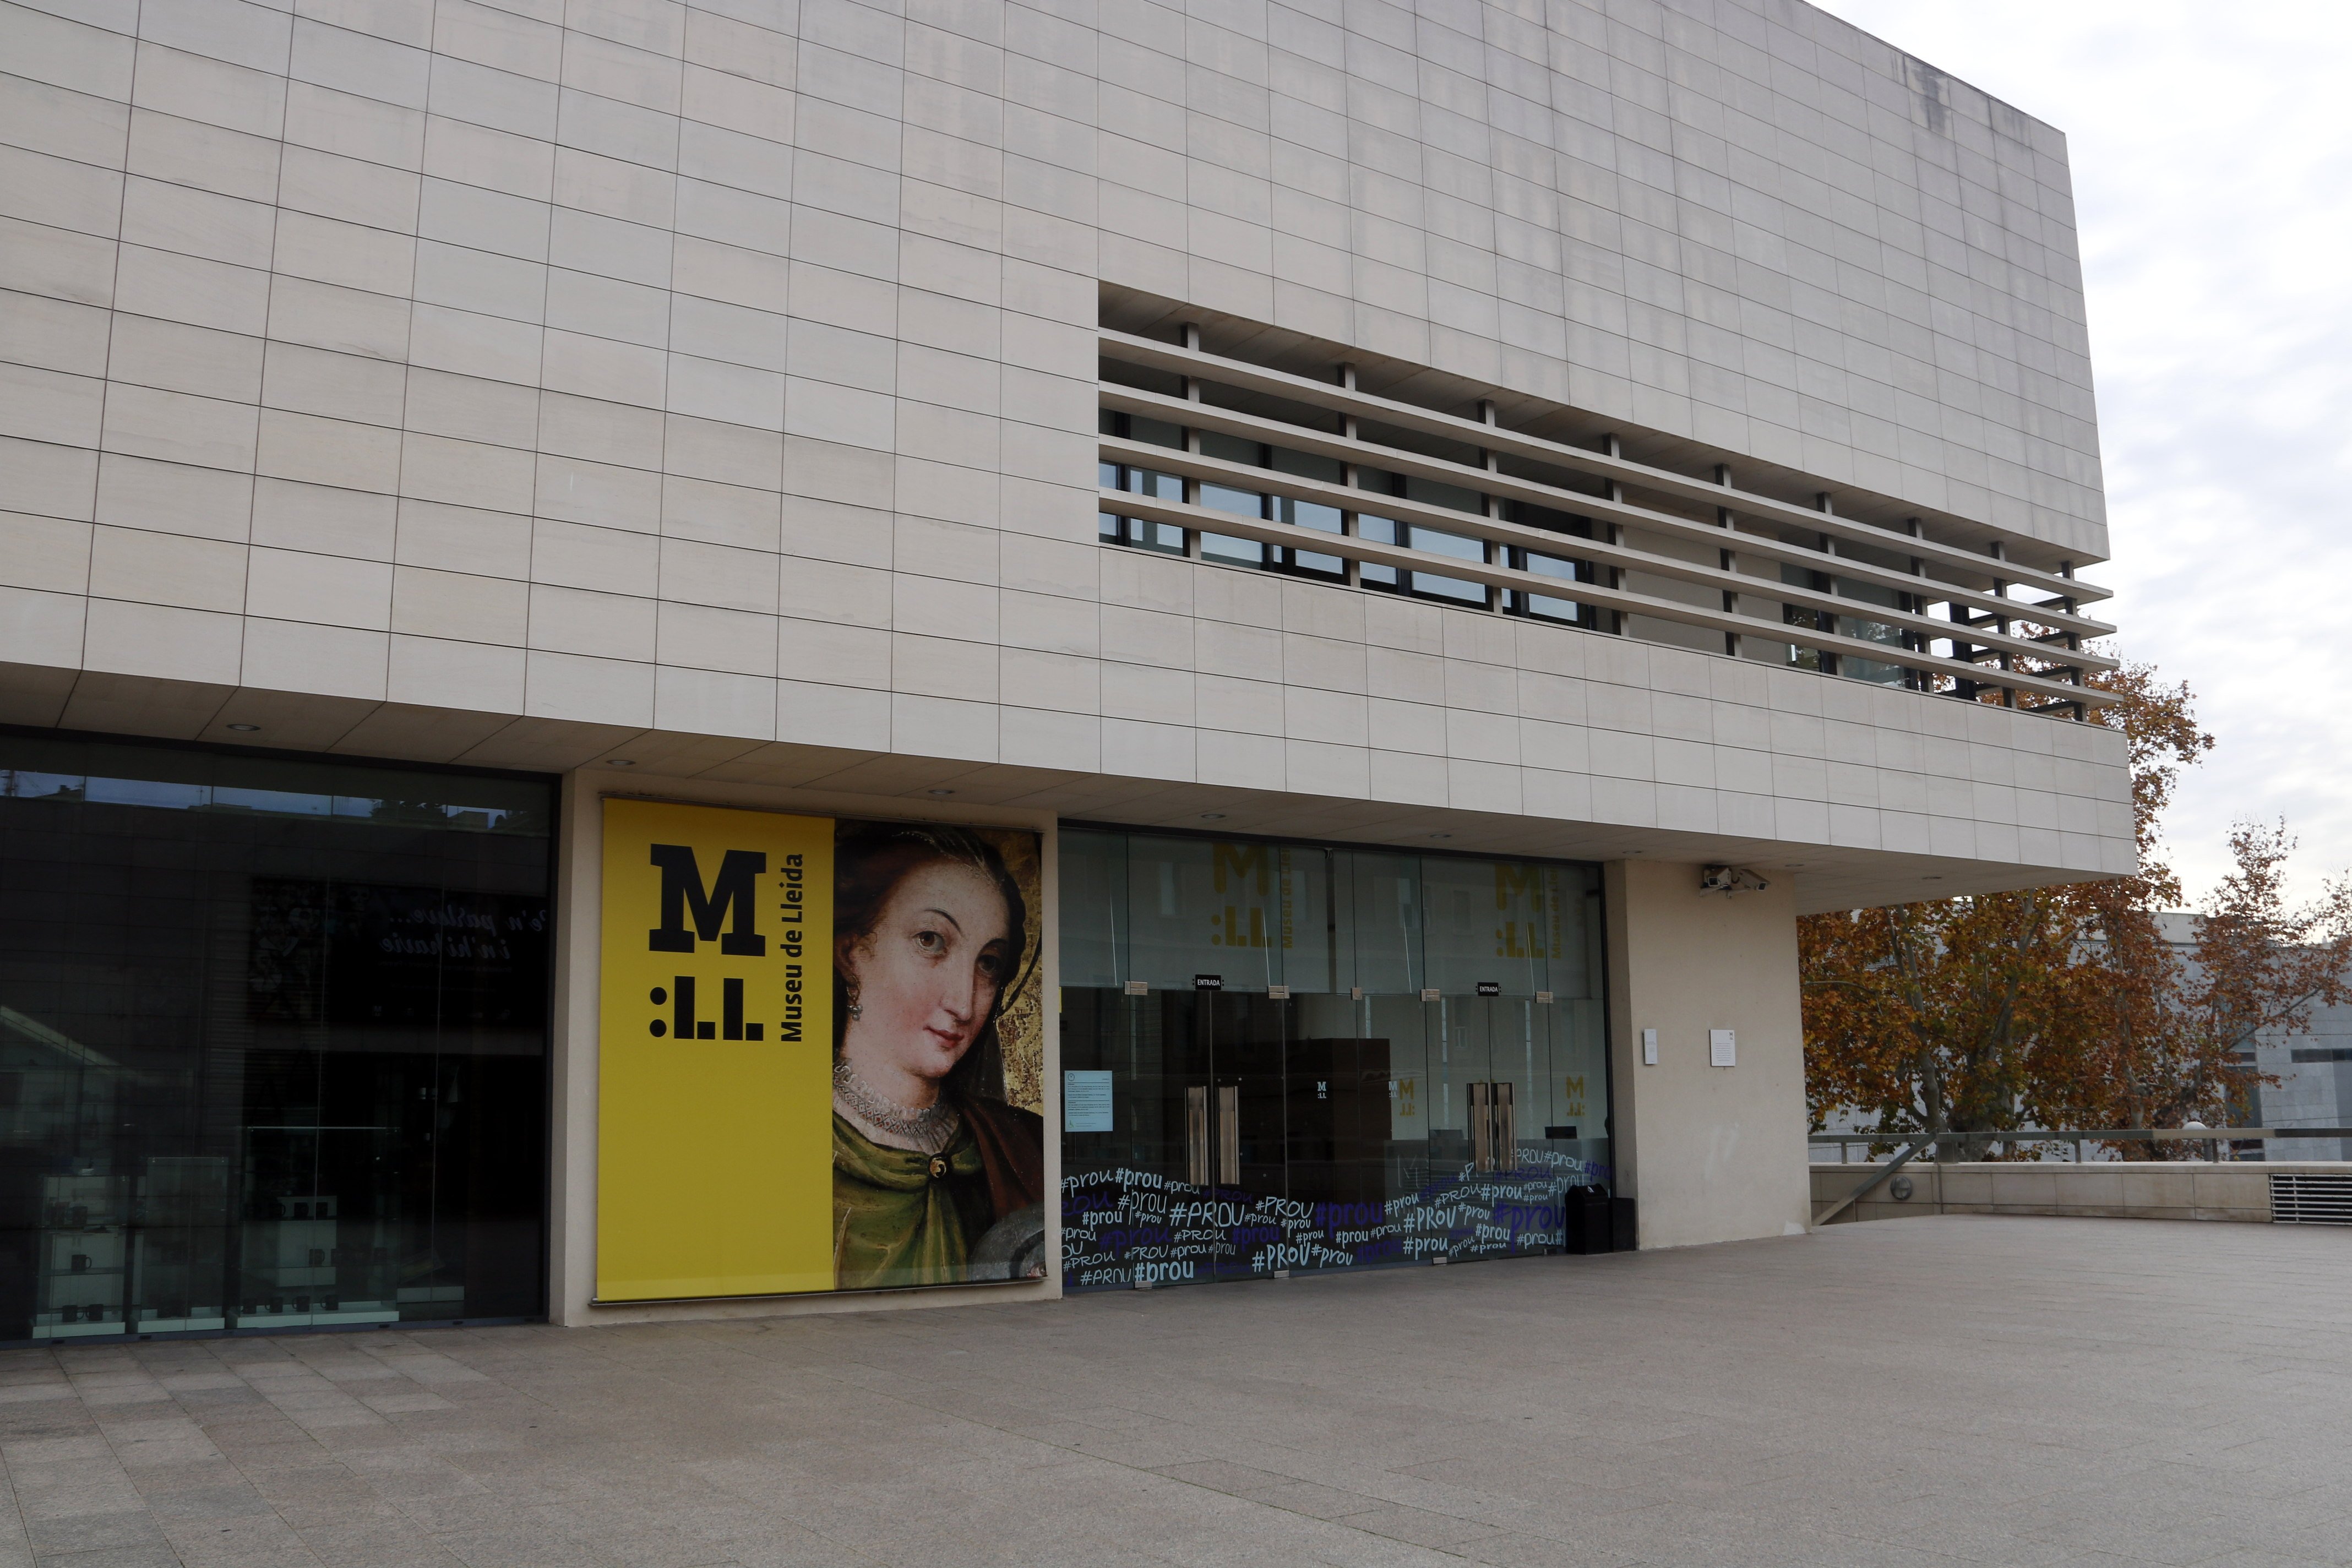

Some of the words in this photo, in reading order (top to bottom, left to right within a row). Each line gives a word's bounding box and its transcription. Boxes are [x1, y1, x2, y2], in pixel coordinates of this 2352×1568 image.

[1212, 842, 1269, 896] M
[1281, 849, 1292, 874] Llei
[778, 854, 803, 923] Lleida
[1495, 862, 1542, 912] M
[649, 843, 766, 956] M
[1282, 900, 1293, 949] Museu
[780, 930, 802, 957] de
[1551, 916, 1561, 959] Museu
[781, 965, 802, 1042] Museu
[1317, 1081, 1326, 1091] M
[1544, 1151, 1582, 1172] #prou
[1585, 1160, 1611, 1182] #pro
[1061, 1169, 1113, 1197] #prou
[1115, 1168, 1162, 1192] #prou
[1164, 1180, 1200, 1194] #prou
[1523, 1180, 1547, 1193] #prou
[1384, 1193, 1419, 1217] #prou
[1435, 1183, 1482, 1209] #PROU
[1480, 1184, 1522, 1207] #prou
[1523, 1194, 1548, 1205] #prou
[1118, 1189, 1167, 1225] #prou
[1169, 1201, 1244, 1227] #PROU
[1256, 1196, 1314, 1218] #PROU
[1082, 1211, 1122, 1231] #prou
[1244, 1213, 1277, 1227] #prou
[1315, 1201, 1384, 1239] #prou
[1061, 1227, 1096, 1242] #prou
[1099, 1228, 1173, 1257] #prou
[1174, 1229, 1226, 1243] #PROU
[1232, 1227, 1280, 1253] #prou
[1296, 1230, 1324, 1247] #prou
[1336, 1230, 1369, 1249] #prou
[1370, 1223, 1402, 1240] #prou
[1476, 1223, 1510, 1244] #prou
[1517, 1233, 1555, 1250] #prou
[1124, 1245, 1168, 1260] #PROU
[1170, 1244, 1206, 1260] #prou
[1208, 1242, 1235, 1262] #prou
[1403, 1237, 1448, 1261] #prou
[1449, 1236, 1476, 1257] #prou
[1470, 1243, 1506, 1254] #prou
[1063, 1251, 1115, 1272] #PROU
